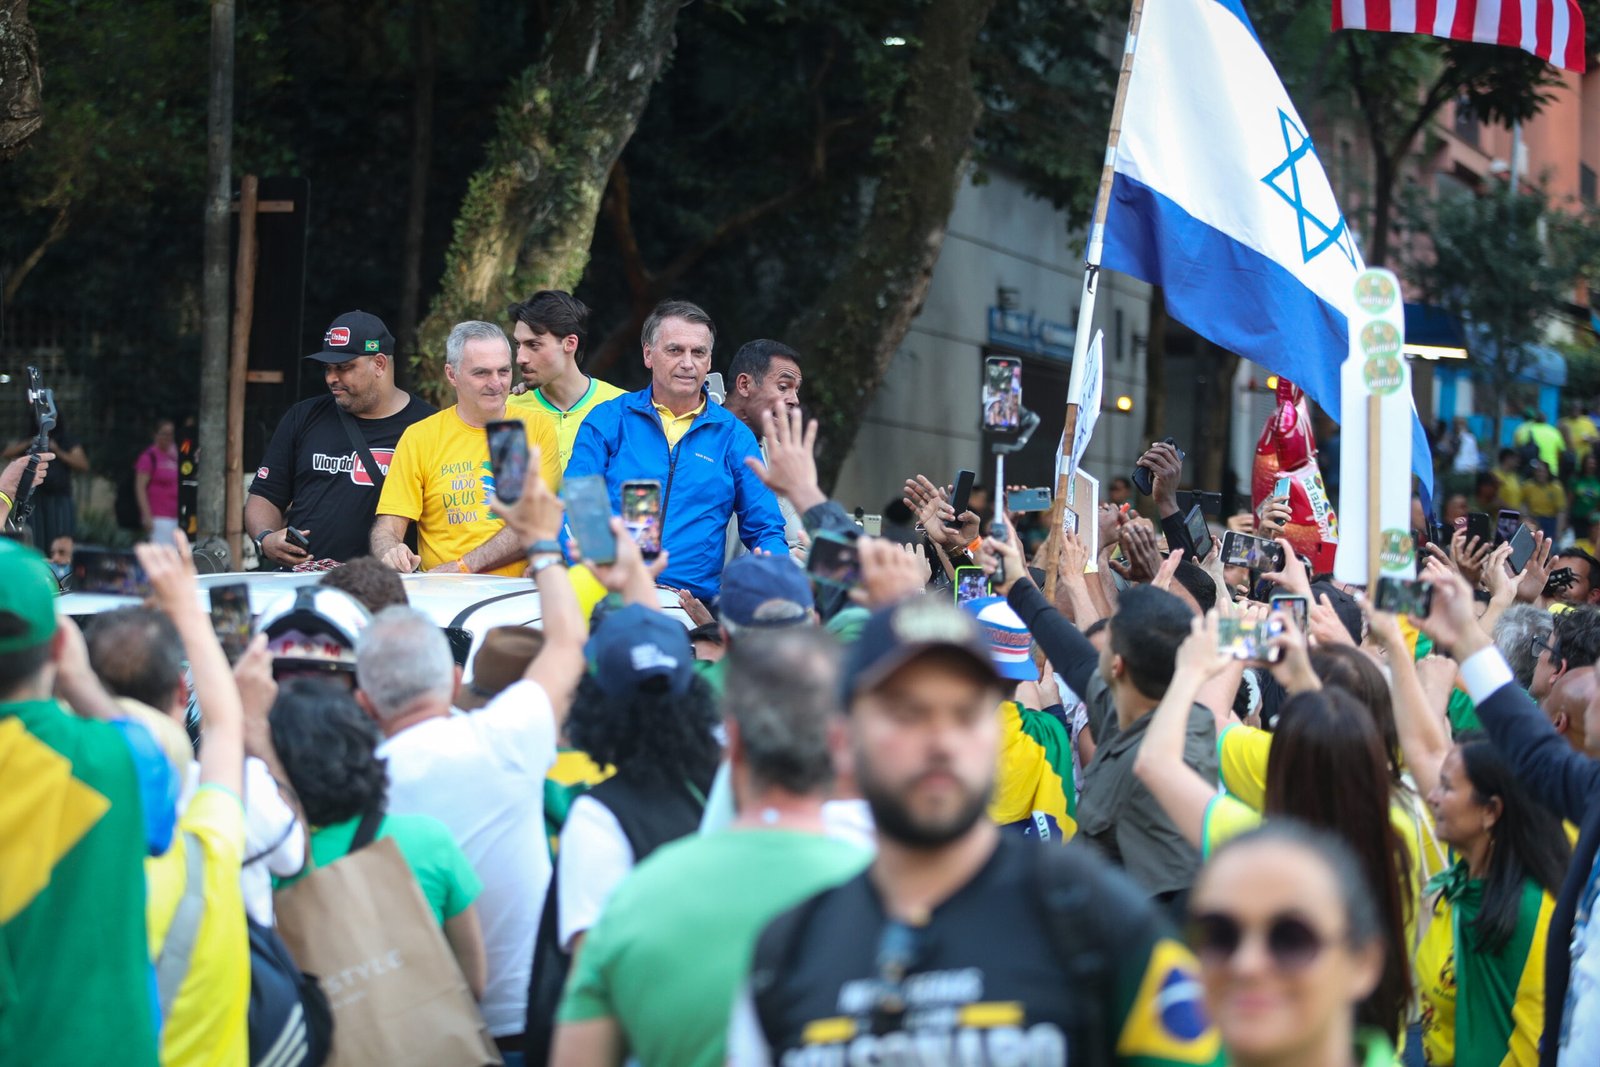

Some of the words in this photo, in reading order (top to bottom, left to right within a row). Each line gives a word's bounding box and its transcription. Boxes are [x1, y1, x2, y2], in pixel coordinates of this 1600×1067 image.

[313, 454, 339, 474] Vlog
[441, 461, 475, 476] BRASIL
[451, 479, 475, 490] TUDO
[443, 491, 475, 508] DEUS
[1310, 490, 1325, 518] VOTEI
[448, 511, 477, 524] TODOS
